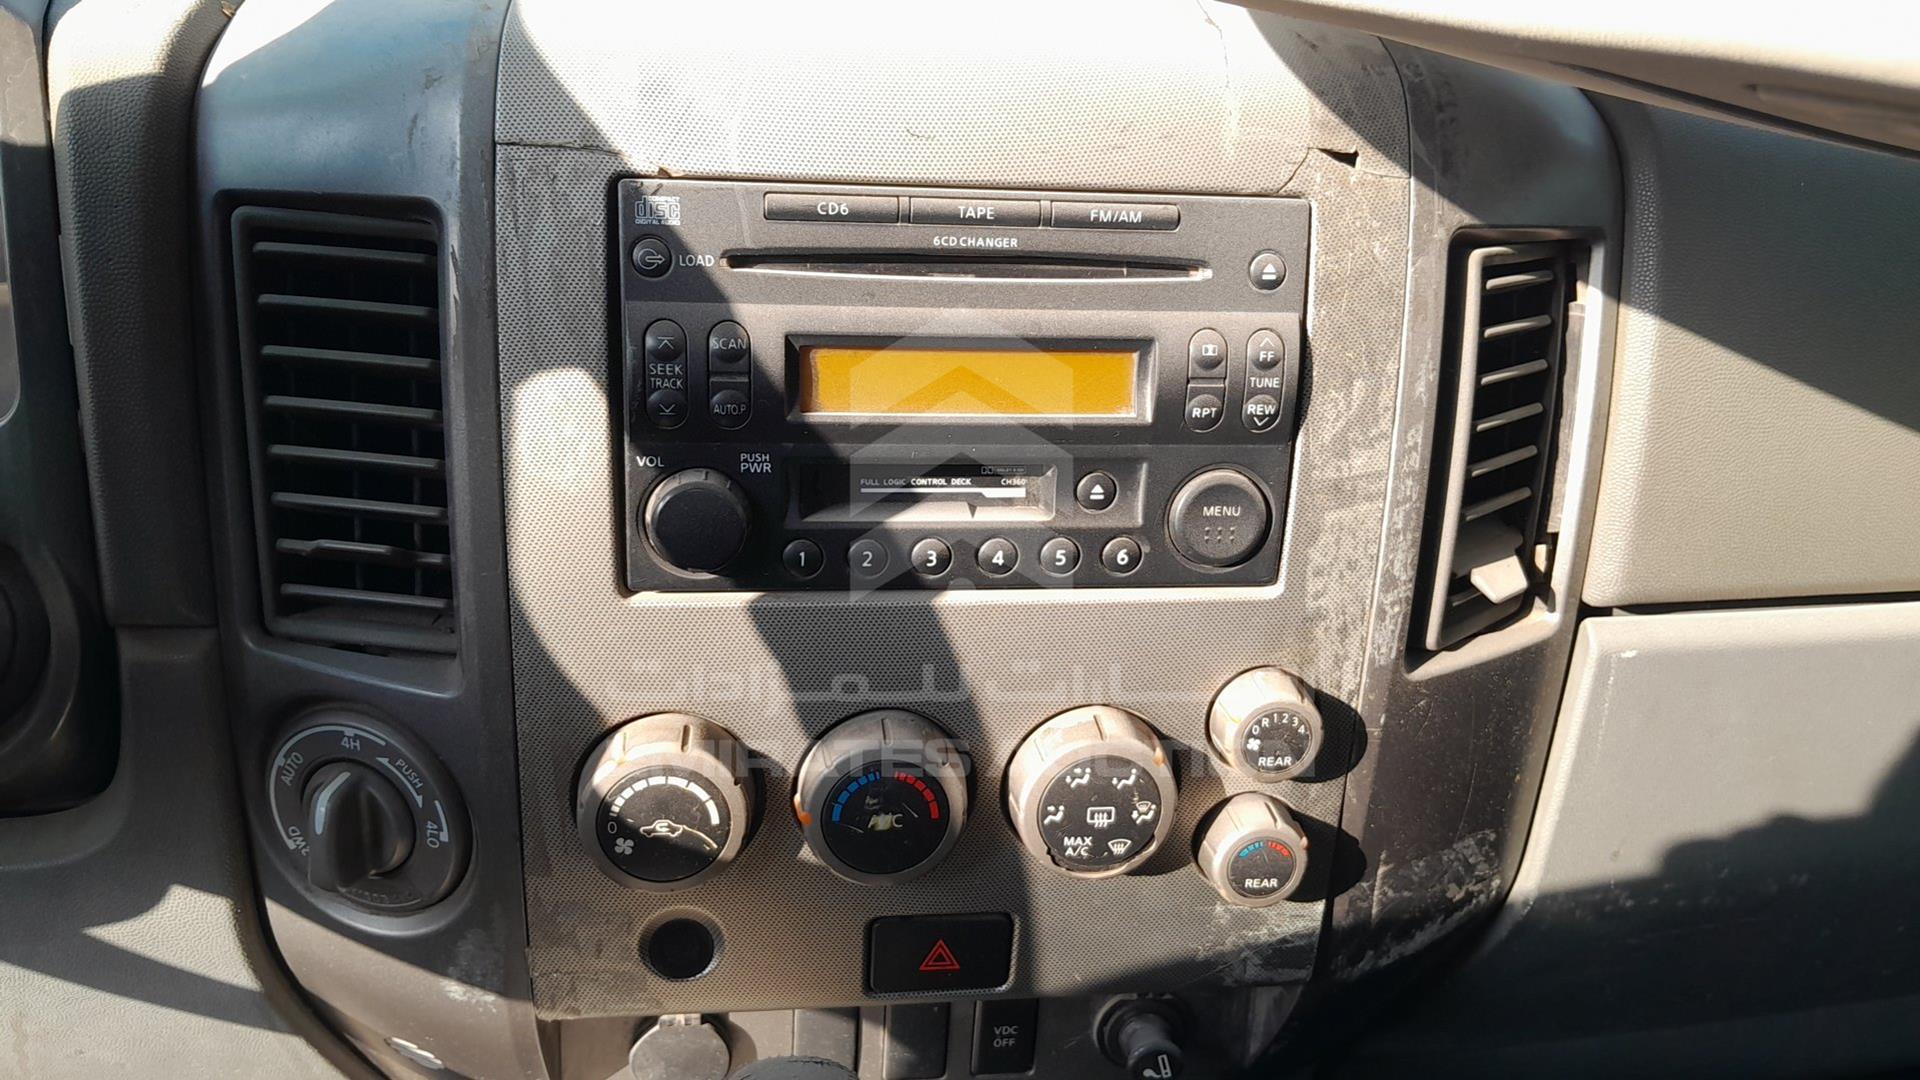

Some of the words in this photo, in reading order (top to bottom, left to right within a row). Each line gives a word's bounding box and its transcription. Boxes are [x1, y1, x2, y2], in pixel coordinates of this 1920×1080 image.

[817, 201, 849, 216] CD6
[957, 206, 995, 220] TAPE
[1090, 209, 1143, 224] FM/AM
[933, 236, 957, 247] 6CD
[959, 237, 1018, 249] CHANGER
[679, 254, 715, 267] LOAD
[711, 337, 746, 350] SCAN
[1259, 350, 1275, 362] FF
[649, 363, 683, 375] SEEK
[650, 378, 684, 390] TRACK
[1249, 376, 1280, 388] TUNE
[1192, 407, 1218, 418] RPT
[1247, 403, 1276, 415] REW
[636, 455, 665, 468] VOL
[740, 452, 770, 462] PUSH
[740, 462, 772, 474] PWR
[860, 478, 880, 486] FULL
[883, 478, 906, 486] LOGIC
[910, 478, 948, 486] CONTROL
[951, 478, 972, 486] DECK
[1202, 505, 1241, 517] MENU
[799, 551, 805, 566] 1
[862, 551, 872, 567] 2
[926, 550, 937, 566] 3
[991, 550, 1004, 565] 4
[1055, 550, 1066, 565] 5
[1116, 549, 1128, 564] 6
[1261, 717, 1269, 728] R
[1282, 713, 1289, 723] 2
[1292, 716, 1299, 727] 3
[1297, 724, 1306, 734] 4
[341, 736, 361, 751] 4H
[1258, 756, 1292, 767] REAR
[280, 751, 304, 786] AUTO
[394, 758, 424, 789] PUSH
[426, 820, 440, 849] 4LO
[1063, 835, 1092, 848] MAX
[1065, 845, 1089, 857] A/C
[1244, 877, 1278, 889] REAR
[993, 1025, 1019, 1035] VDC
[993, 1038, 1016, 1047] OFF
